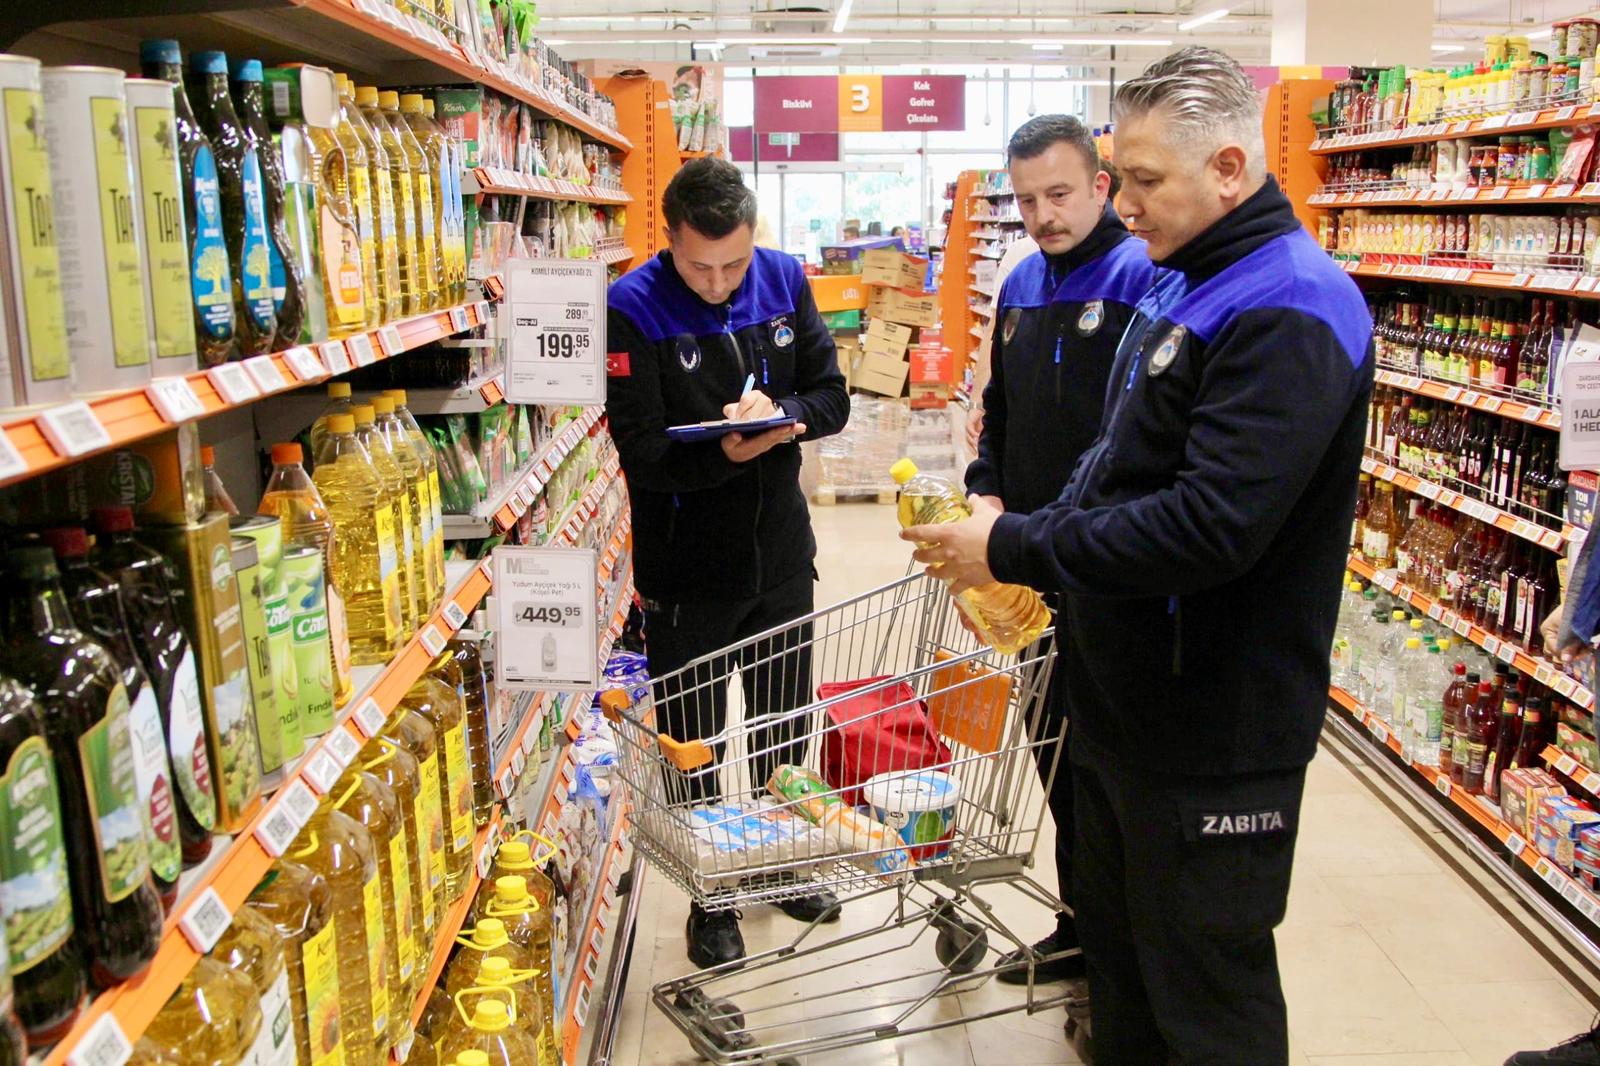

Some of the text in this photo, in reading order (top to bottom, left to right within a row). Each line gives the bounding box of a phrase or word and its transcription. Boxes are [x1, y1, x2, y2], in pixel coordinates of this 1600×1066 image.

[913, 81, 931, 91] Kek
[851, 84, 870, 112] 3
[909, 97, 935, 107] Gofret
[782, 99, 812, 109] Bisküvi
[907, 114, 938, 124] Çikolata
[1202, 811, 1284, 834] ZABITA
